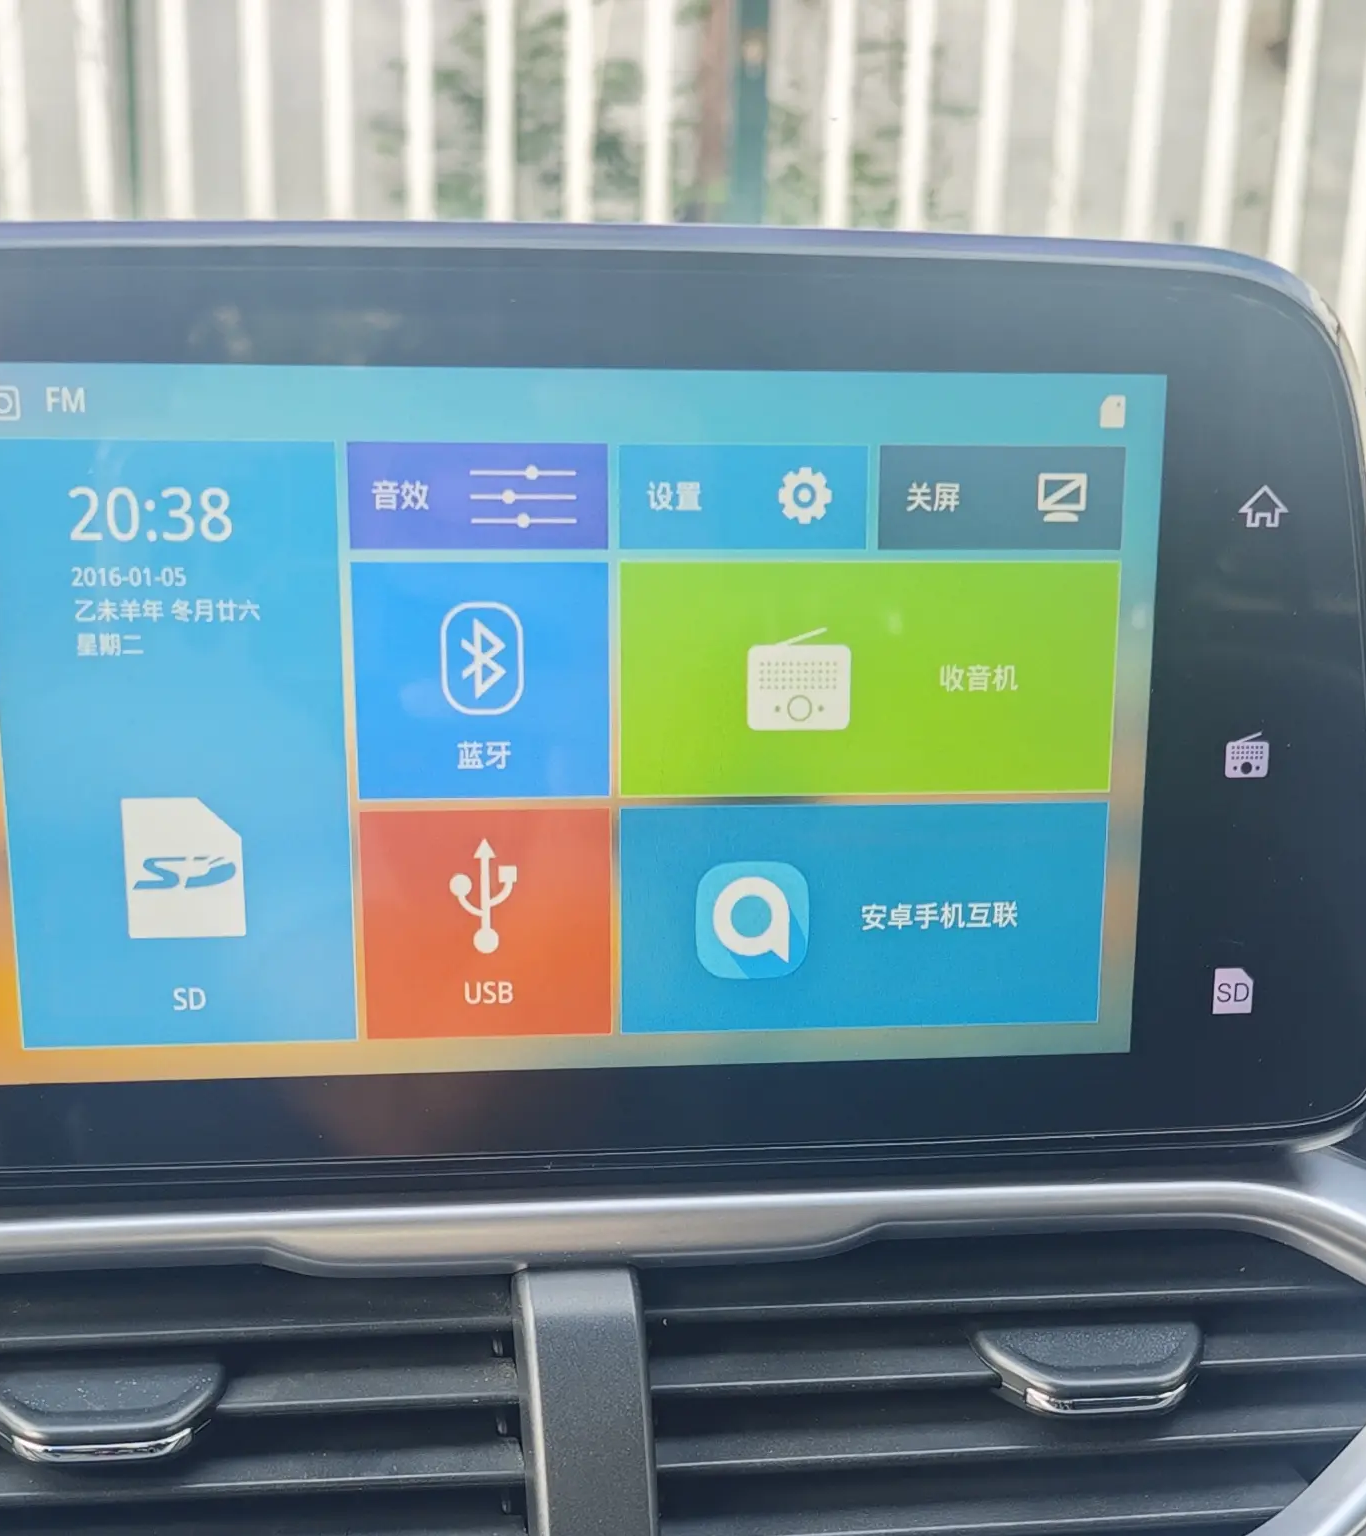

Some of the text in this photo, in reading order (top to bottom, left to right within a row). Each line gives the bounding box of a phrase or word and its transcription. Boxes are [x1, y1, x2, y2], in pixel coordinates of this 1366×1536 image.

[45, 387, 86, 414] FM
[371, 481, 430, 511] 音效
[647, 481, 702, 512] 设置
[906, 482, 960, 513] 关屏
[68, 486, 234, 544] 20:38
[70, 565, 187, 588] 2016-01-05
[74, 598, 261, 623] 乙未羊年 冬月廿六
[76, 633, 145, 657] 星期二
[939, 664, 1019, 692] 收音机
[457, 741, 512, 770] 蓝牙
[861, 901, 1019, 931] 安卓手机互联
[172, 987, 207, 1012] SD
[464, 981, 514, 1005] USB
[1216, 982, 1250, 1003] SD
